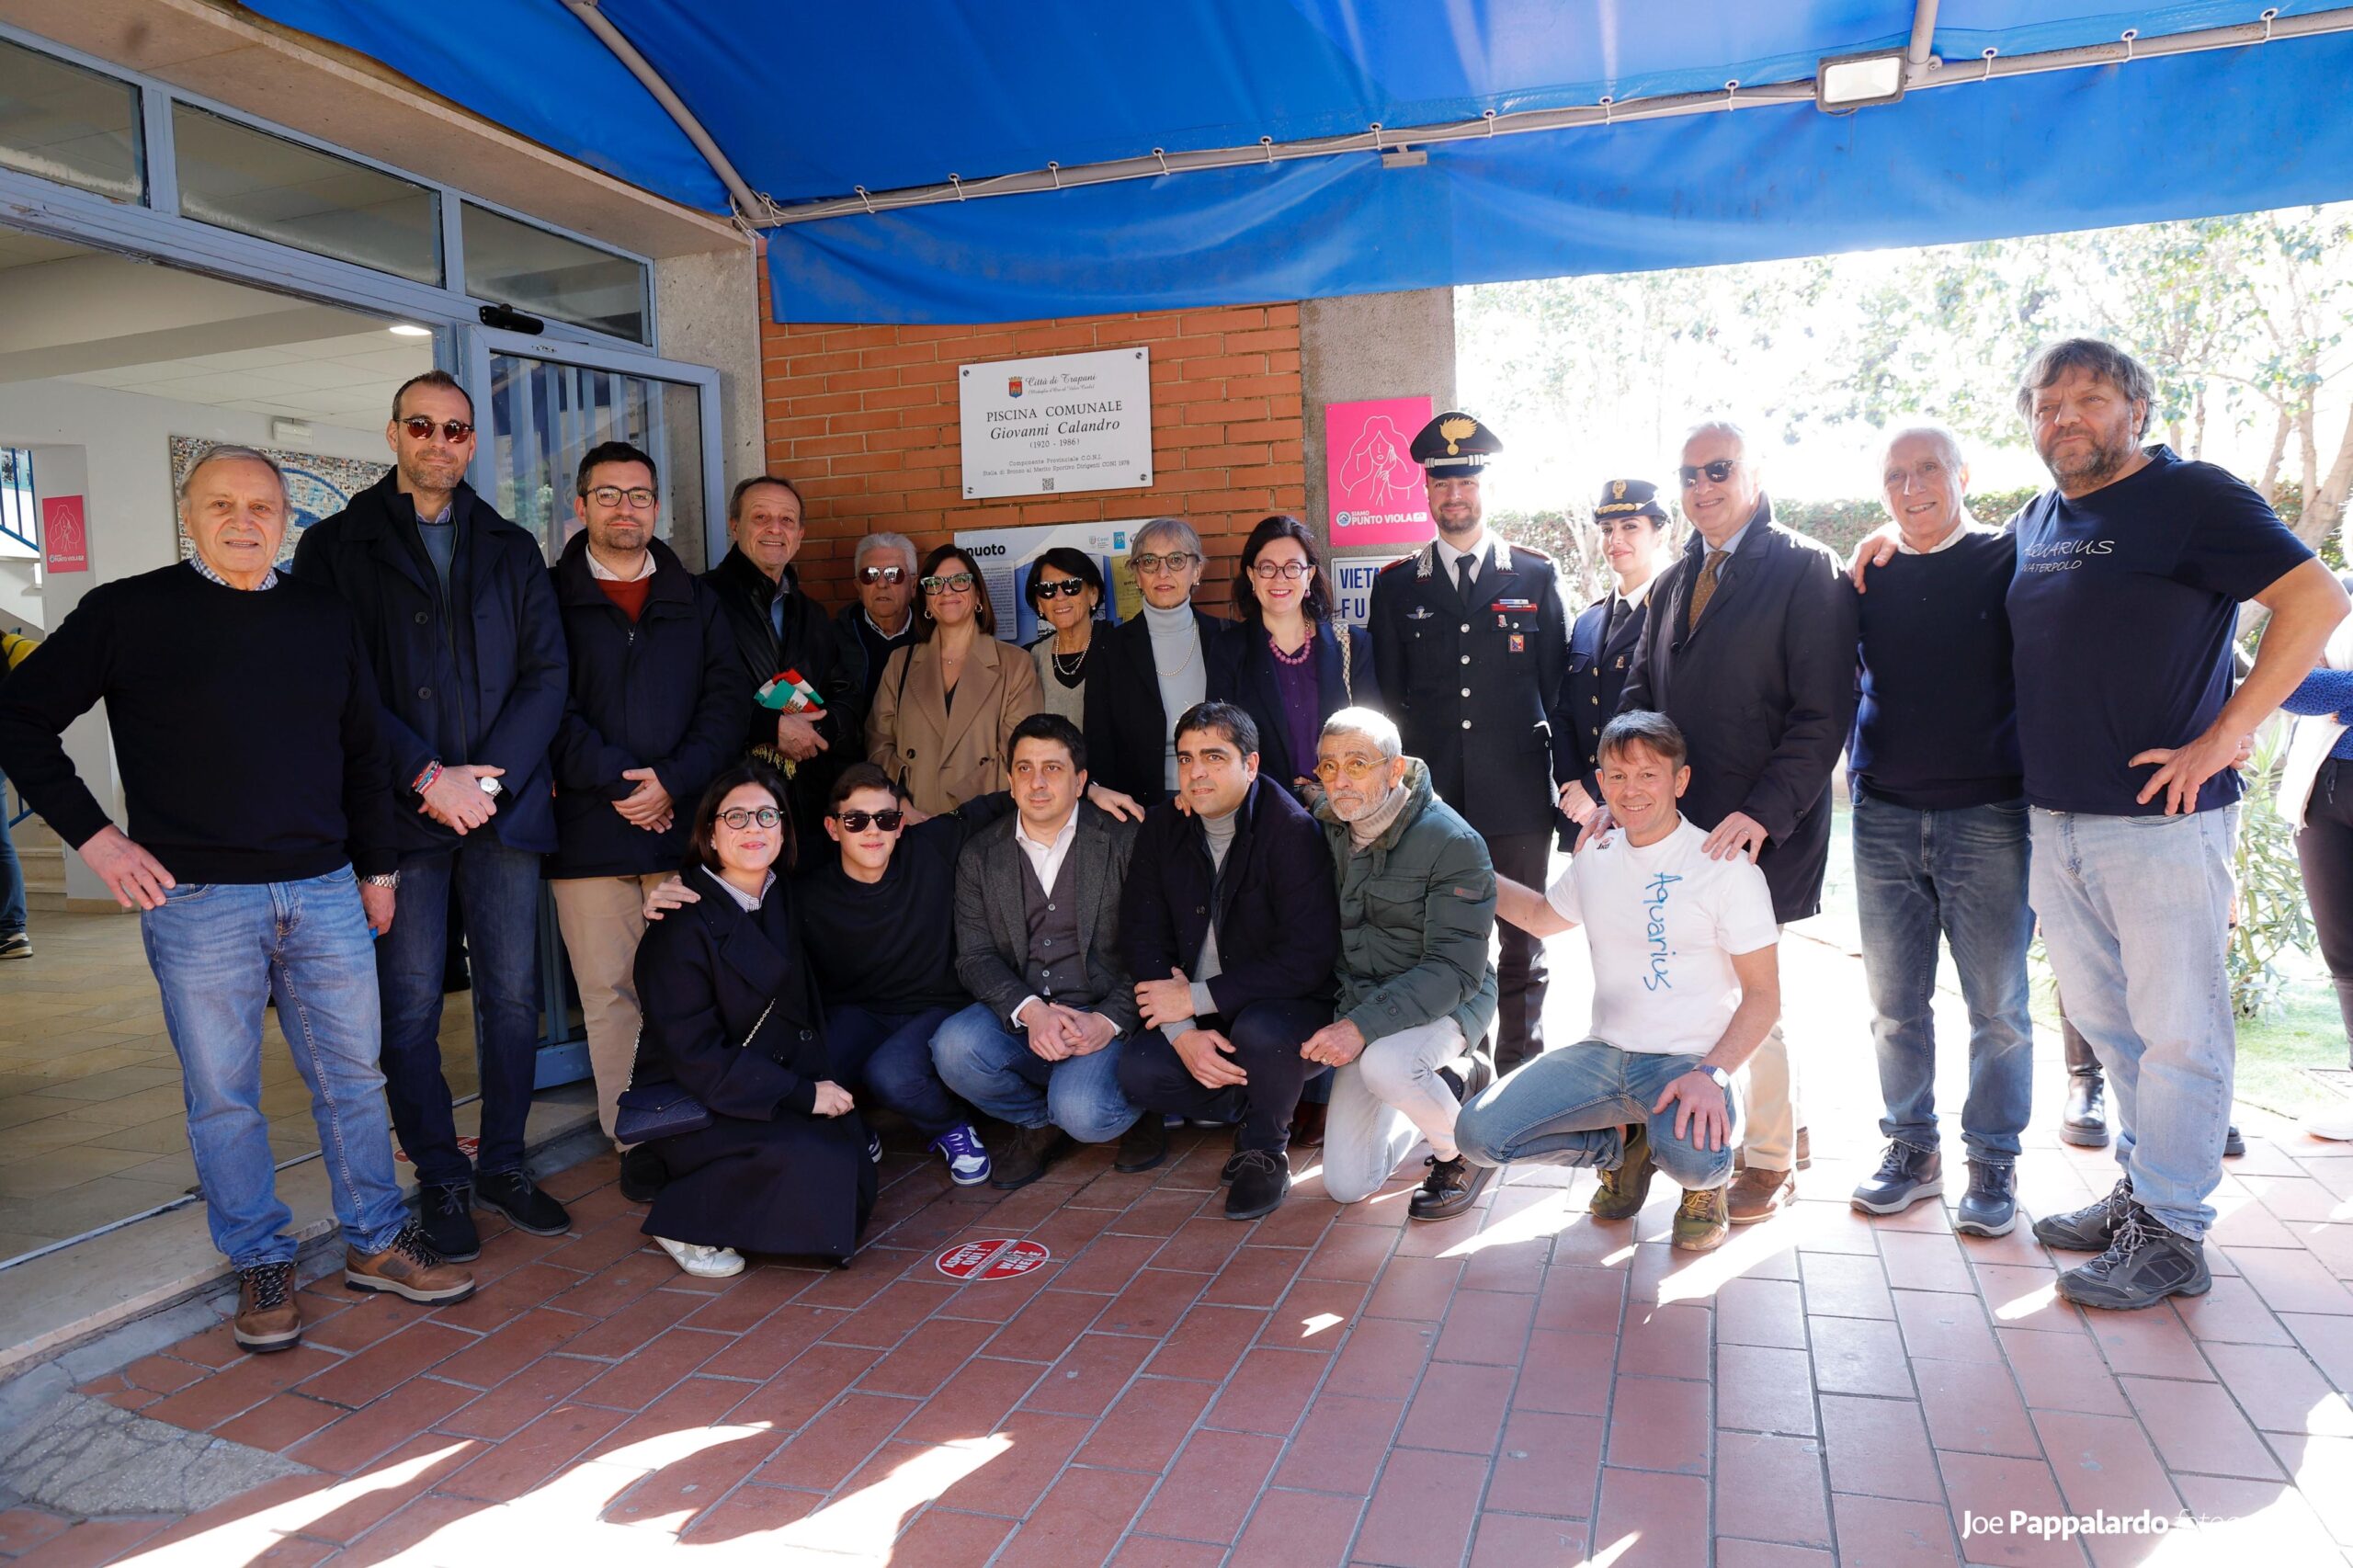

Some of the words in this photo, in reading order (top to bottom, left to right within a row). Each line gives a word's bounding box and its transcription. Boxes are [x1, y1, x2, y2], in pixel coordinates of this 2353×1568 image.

[1050, 376, 1058, 384] di
[1061, 372, 1097, 384] Trapani
[986, 408, 1038, 422] PISCINA
[1045, 401, 1123, 416] COMUNALE
[991, 424, 1050, 439] Giovanni
[1058, 418, 1120, 434] Calandro
[1029, 440, 1051, 449] (1920
[1060, 437, 1080, 446] 1986)
[1351, 515, 1383, 526] PUNTO
[1384, 513, 1414, 524] VIOLA
[1339, 567, 1380, 588] VIET
[1643, 872, 1683, 991] Aquarius
[942, 1244, 983, 1268] ASPETTA
